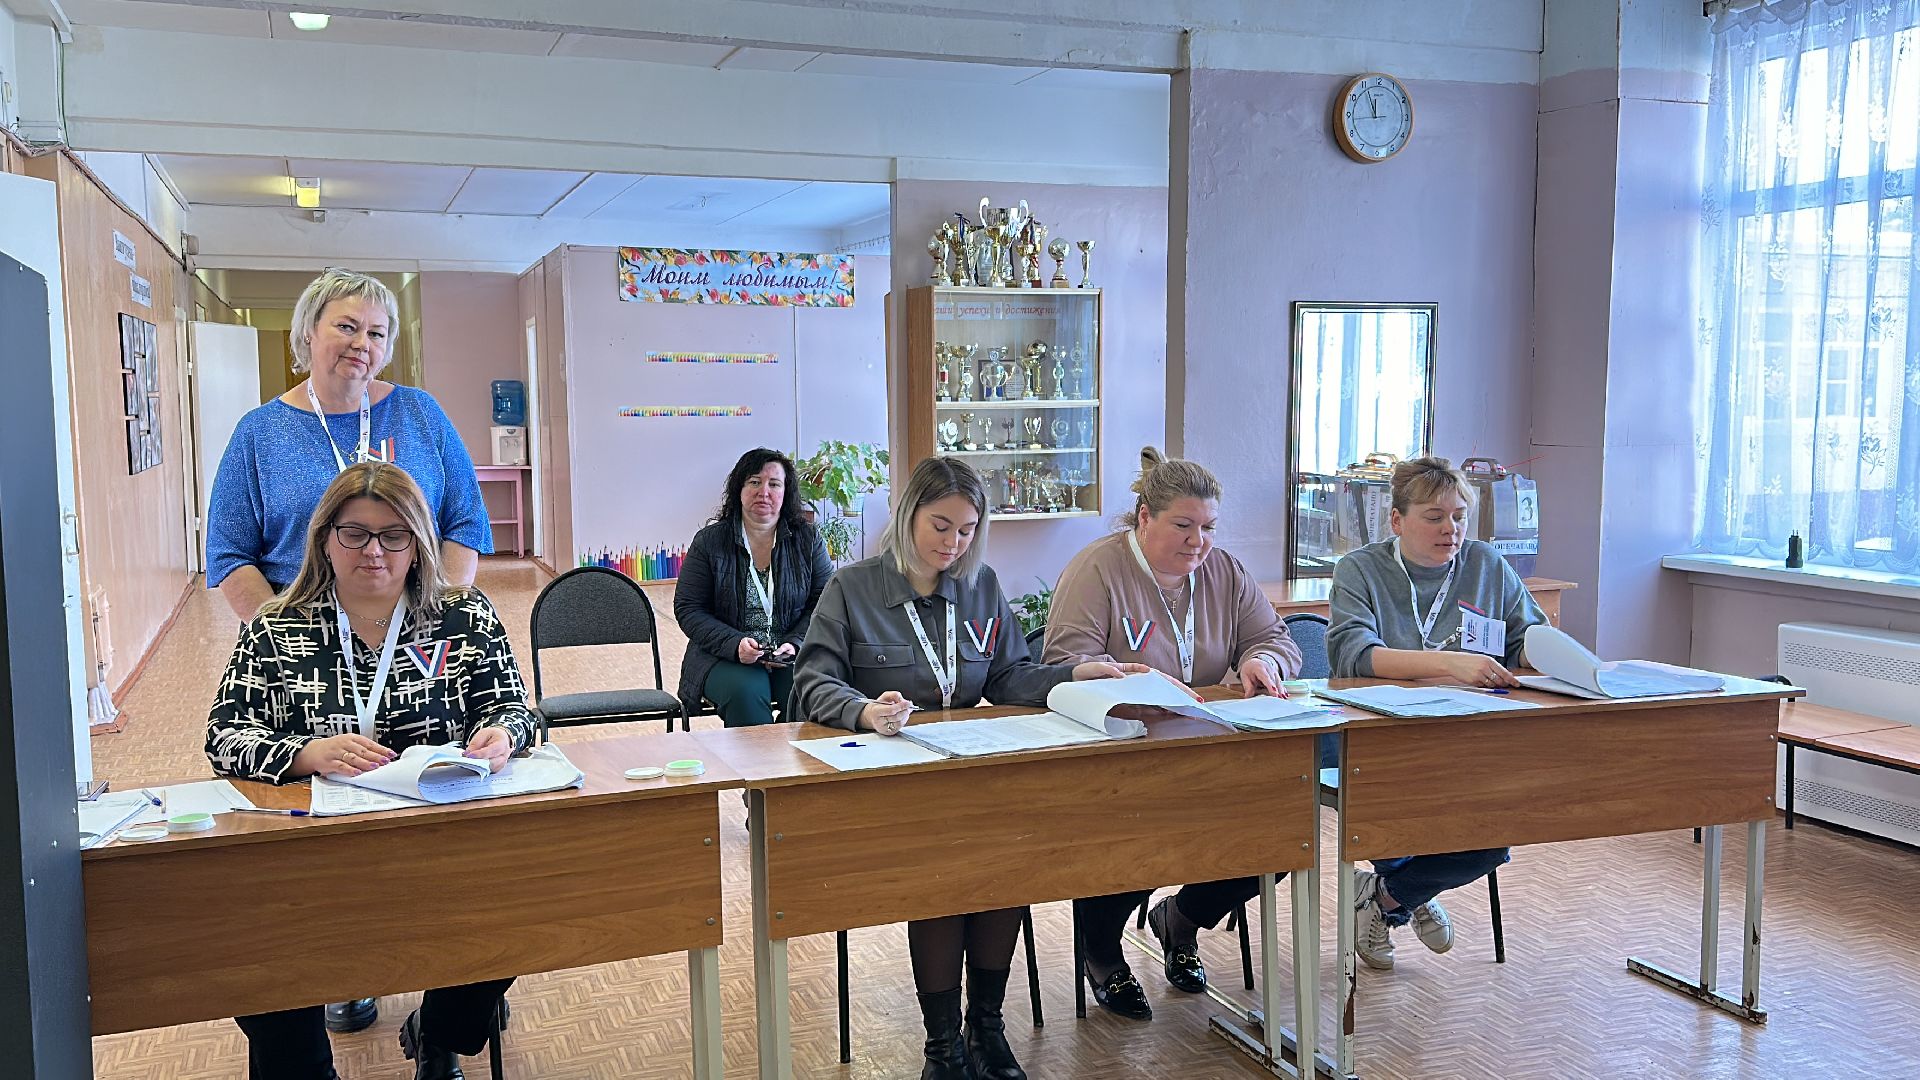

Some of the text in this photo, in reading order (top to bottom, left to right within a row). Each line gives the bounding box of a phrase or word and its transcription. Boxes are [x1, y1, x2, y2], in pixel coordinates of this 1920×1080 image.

[641, 261, 838, 289] Моим любимым!
[935, 307, 953, 316] аши
[1521, 496, 1534, 521] 3
